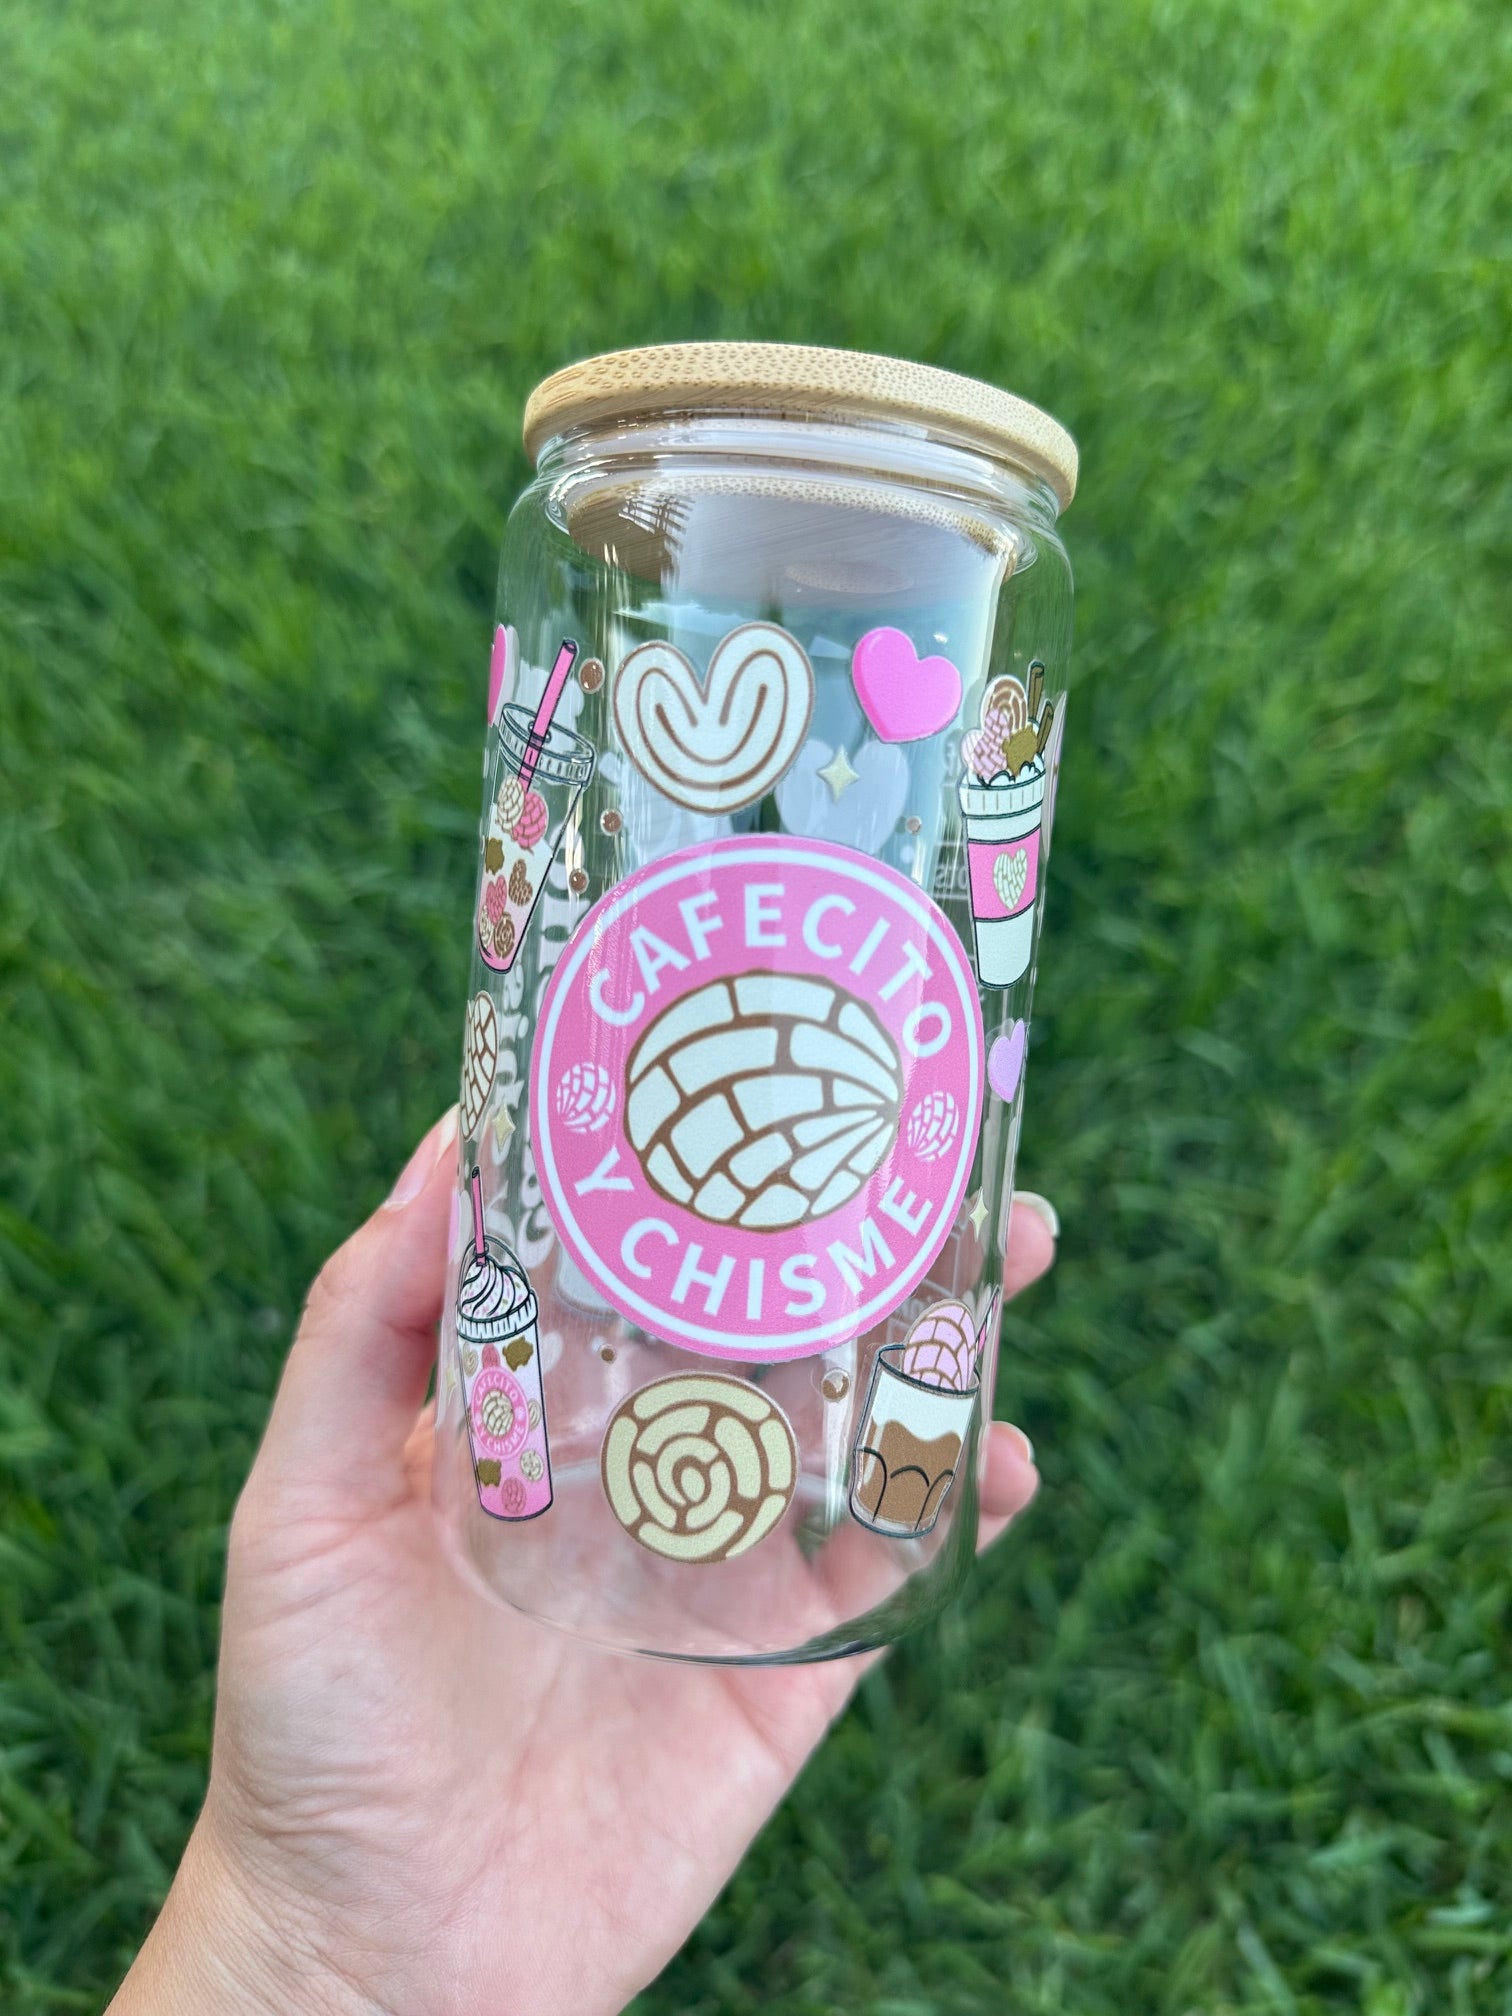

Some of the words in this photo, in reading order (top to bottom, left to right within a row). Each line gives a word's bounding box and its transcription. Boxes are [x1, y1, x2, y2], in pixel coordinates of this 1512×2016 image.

[588, 883, 952, 1058] CAFECITO
[574, 1145, 635, 1197] Y
[620, 1175, 934, 1321] CHISME
